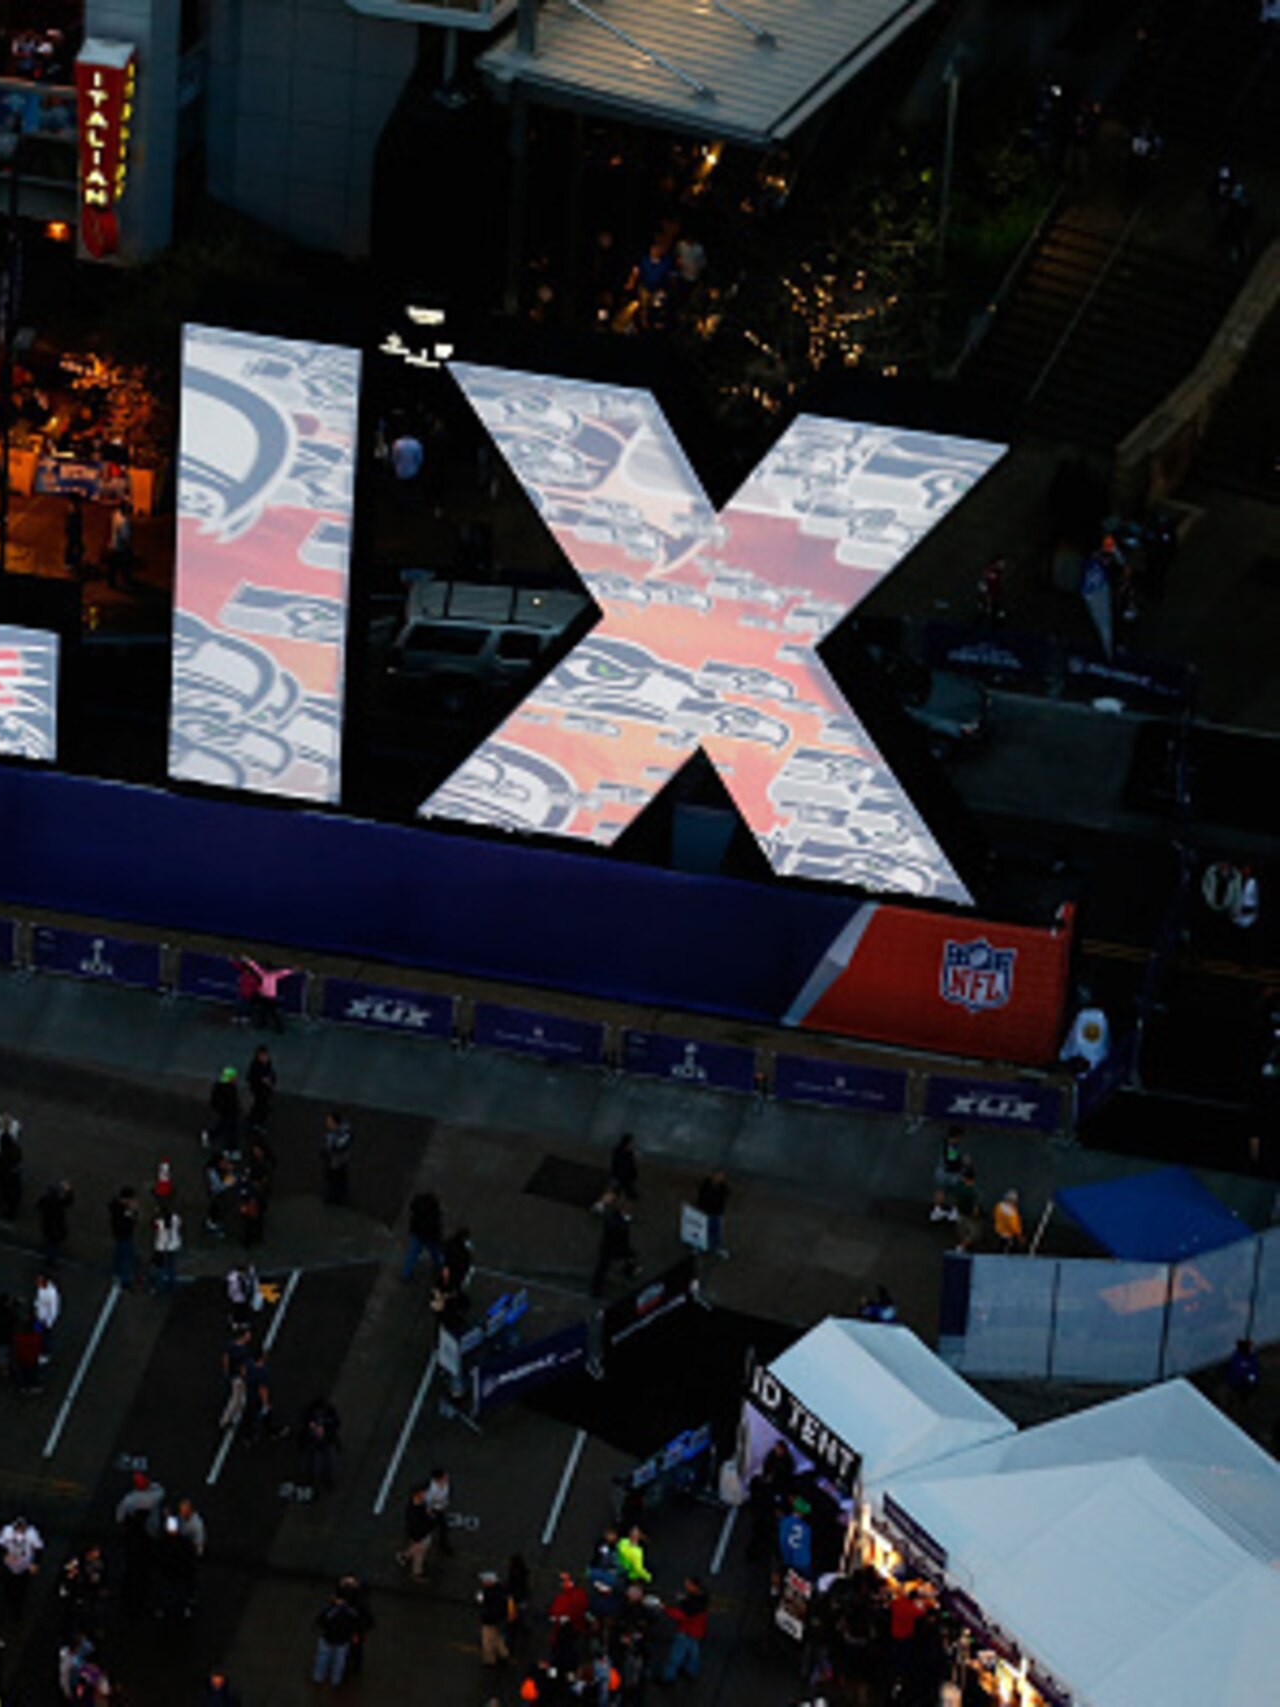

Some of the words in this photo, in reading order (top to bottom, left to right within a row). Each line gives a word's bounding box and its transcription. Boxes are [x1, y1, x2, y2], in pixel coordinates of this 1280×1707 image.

[83, 70, 110, 207] ITALIAN
[948, 968, 1002, 1002] NFL
[343, 996, 433, 1028] XLIX
[946, 1092, 1040, 1123] XLIX
[751, 1364, 783, 1410] ID
[787, 1396, 855, 1477] TENT
